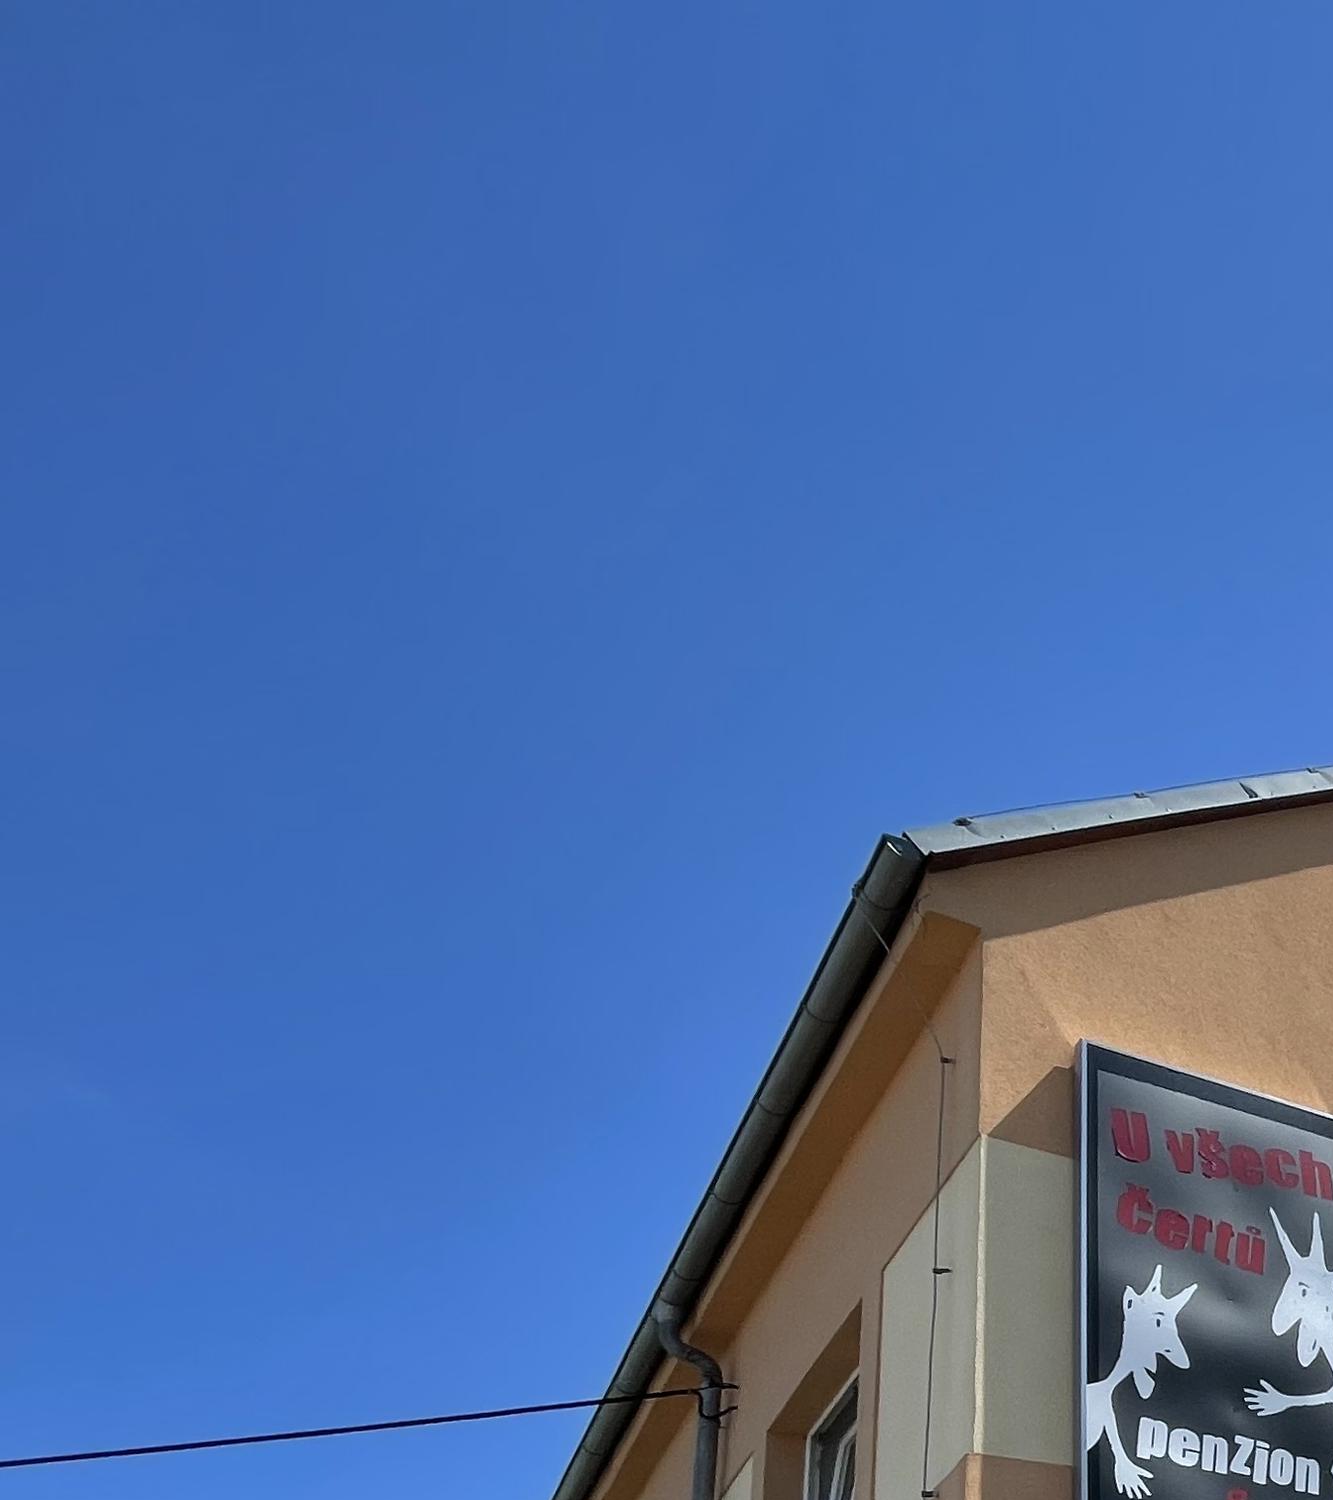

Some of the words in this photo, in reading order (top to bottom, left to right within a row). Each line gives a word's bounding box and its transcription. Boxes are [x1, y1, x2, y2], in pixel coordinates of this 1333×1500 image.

[1110, 1107, 1150, 1163] U
[1116, 1182, 1266, 1275] čertů
[1136, 1416, 1321, 1496] penzion
